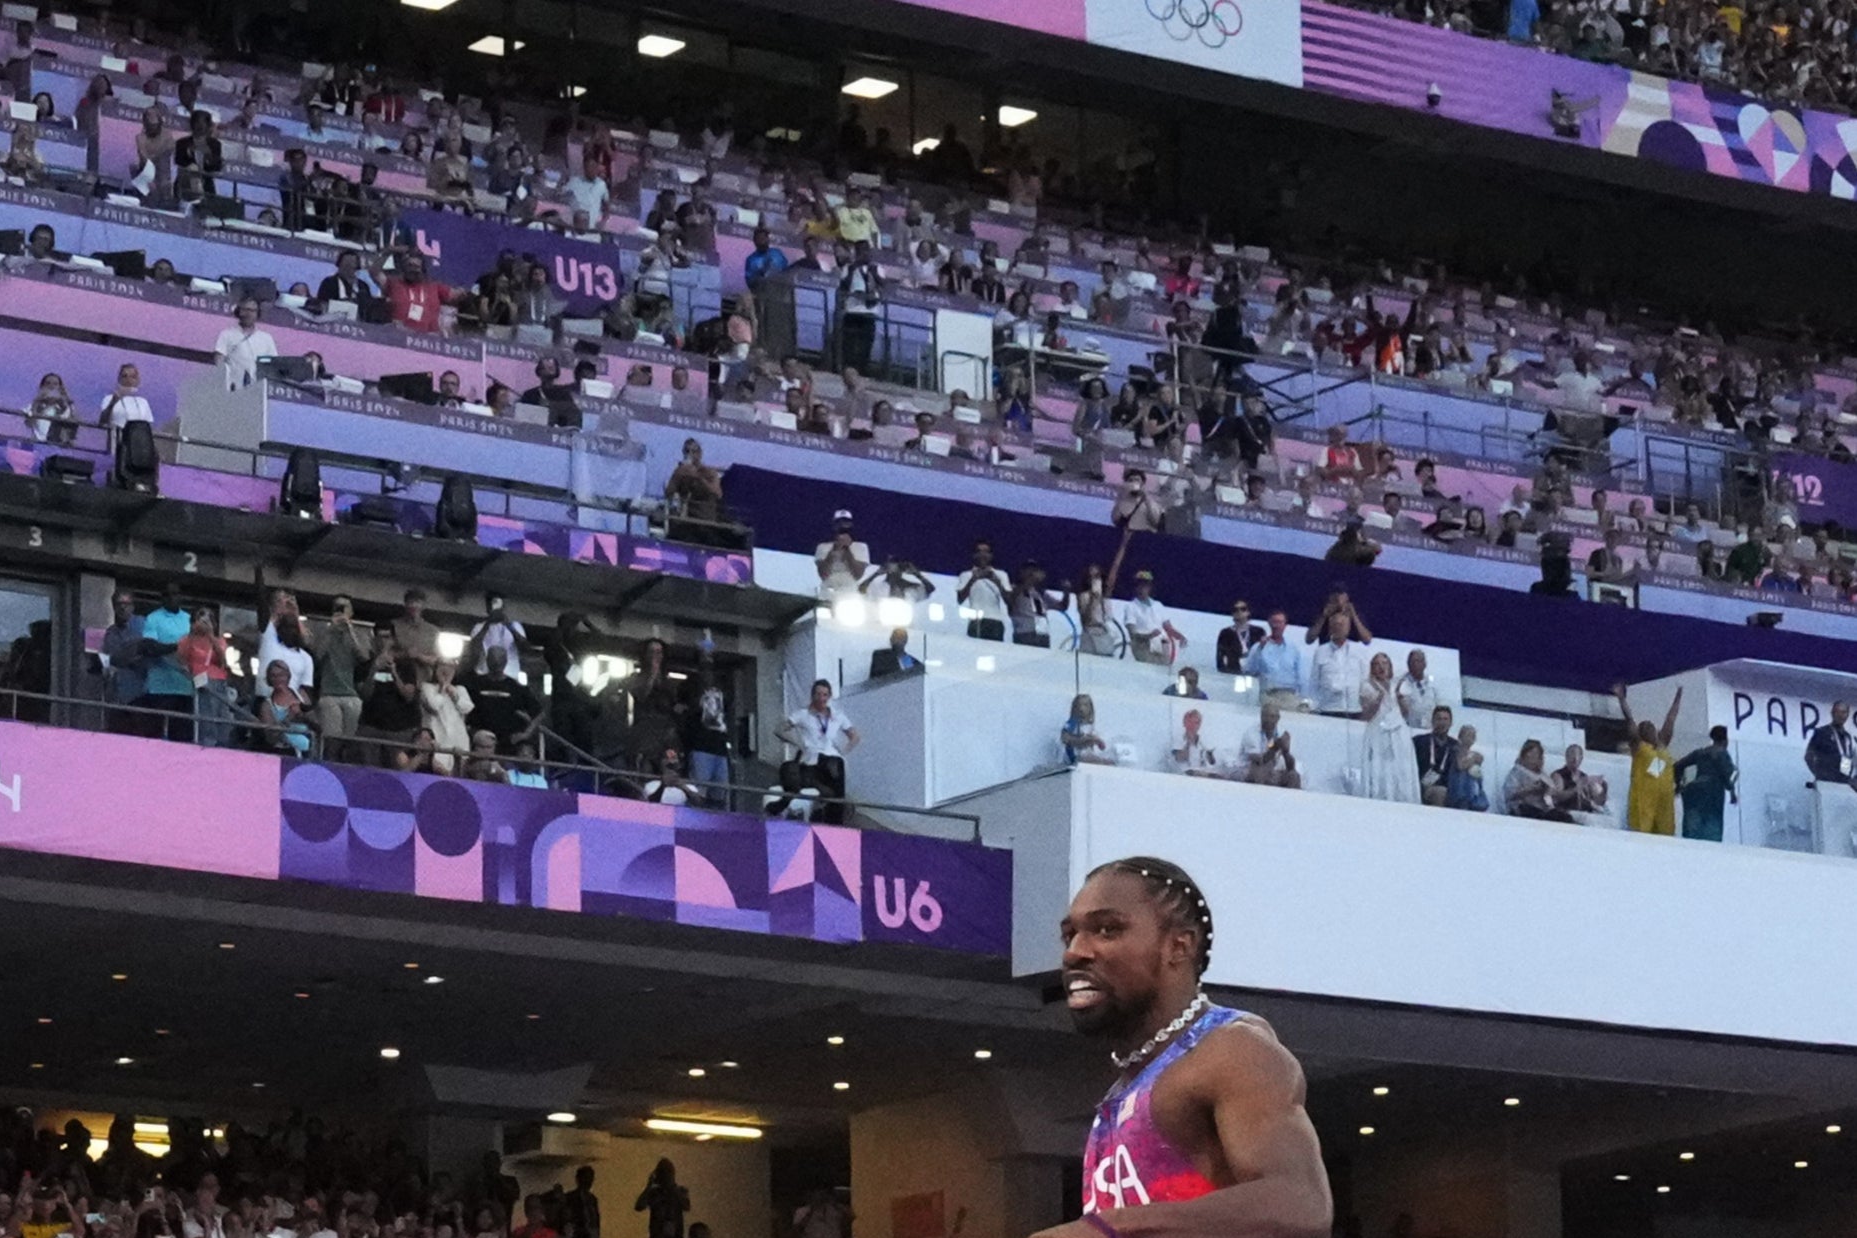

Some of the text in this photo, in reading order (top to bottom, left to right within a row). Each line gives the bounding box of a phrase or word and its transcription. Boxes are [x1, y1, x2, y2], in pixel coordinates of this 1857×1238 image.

[555, 255, 618, 301] U13
[28, 525, 43, 548] 3
[183, 551, 198, 573] 2
[874, 875, 943, 933] U6
